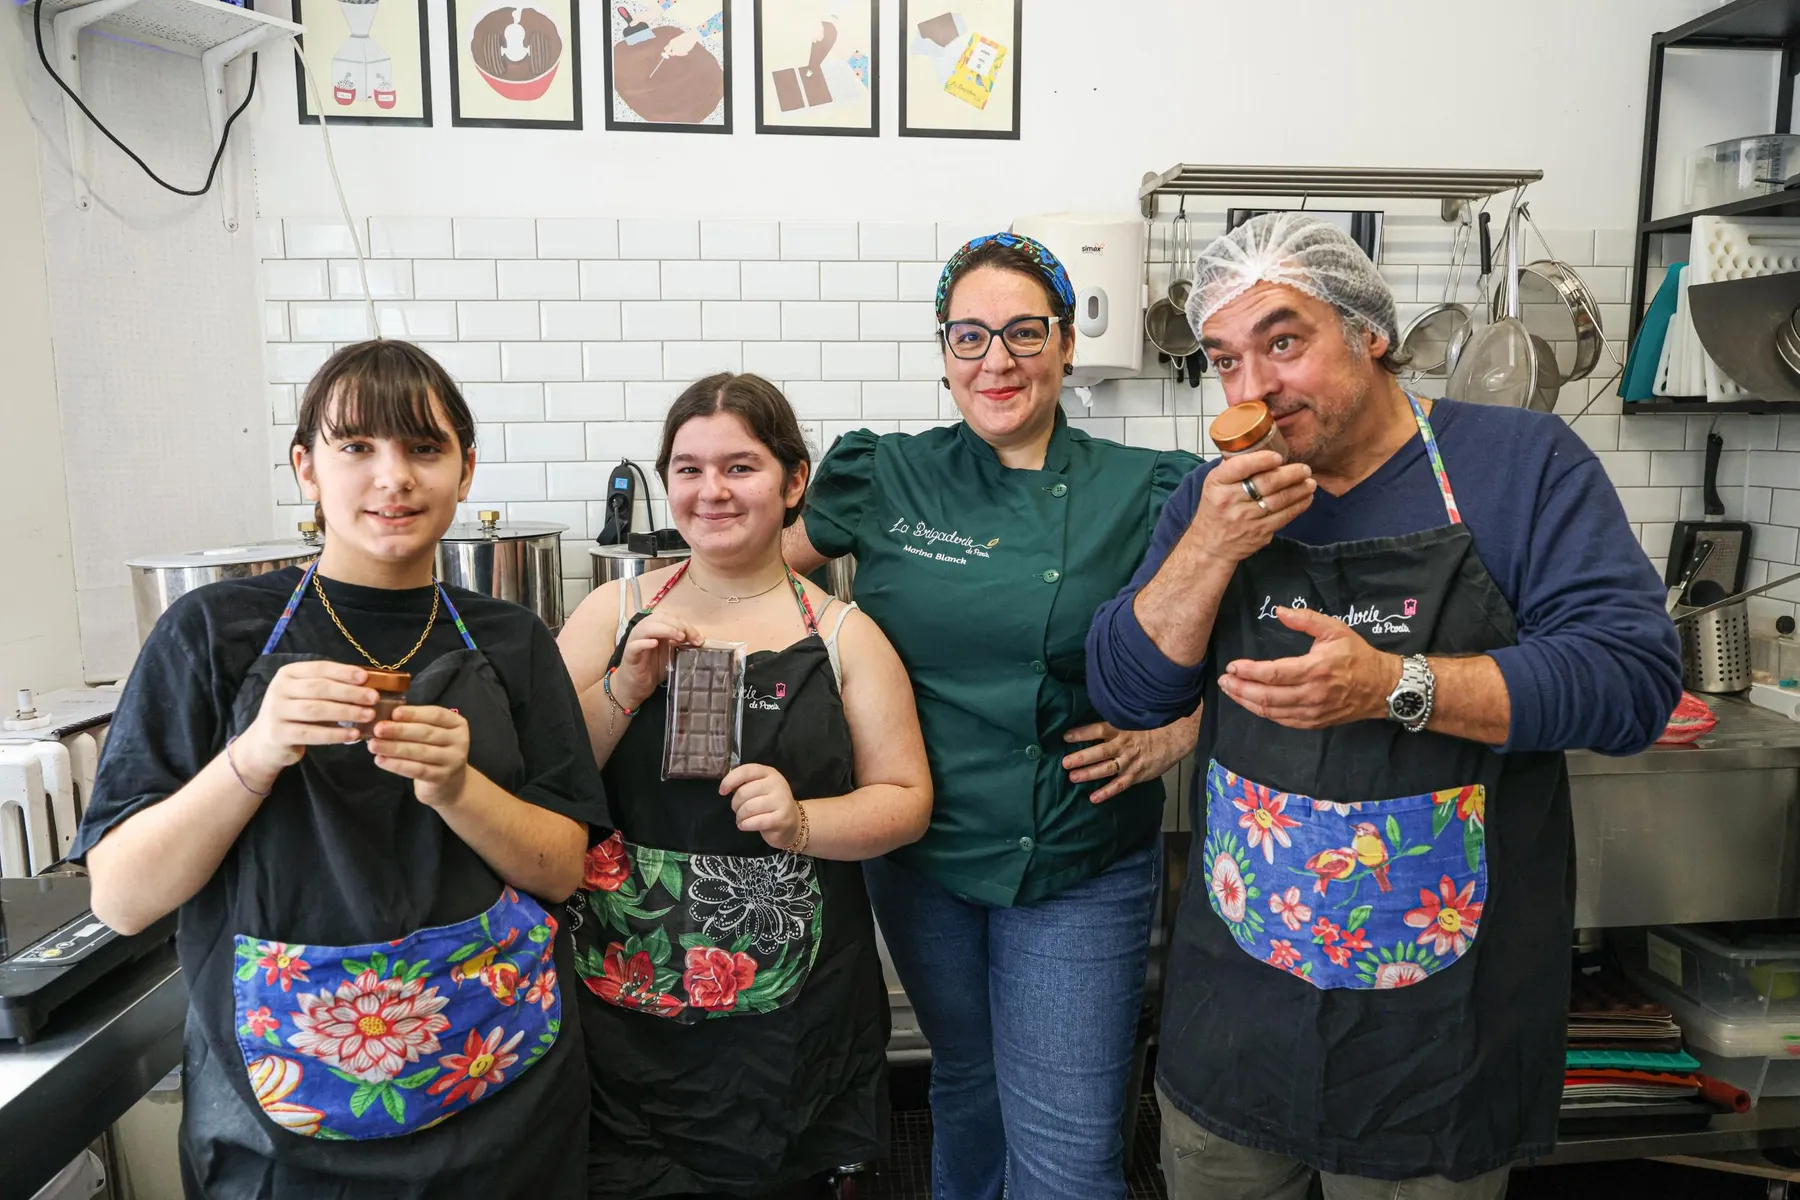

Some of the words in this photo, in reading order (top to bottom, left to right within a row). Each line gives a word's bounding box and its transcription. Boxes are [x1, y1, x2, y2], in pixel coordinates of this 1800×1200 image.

[889, 517, 910, 533] La
[913, 521, 982, 548] Brigaderie
[903, 544, 933, 559] Marina
[935, 552, 967, 565] Blanck
[965, 547, 973, 555] de
[973, 548, 990, 558] Paris
[1372, 623, 1382, 634] de
[1384, 622, 1410, 634] Paris
[749, 700, 758, 709] de
[759, 700, 781, 710] Paris
